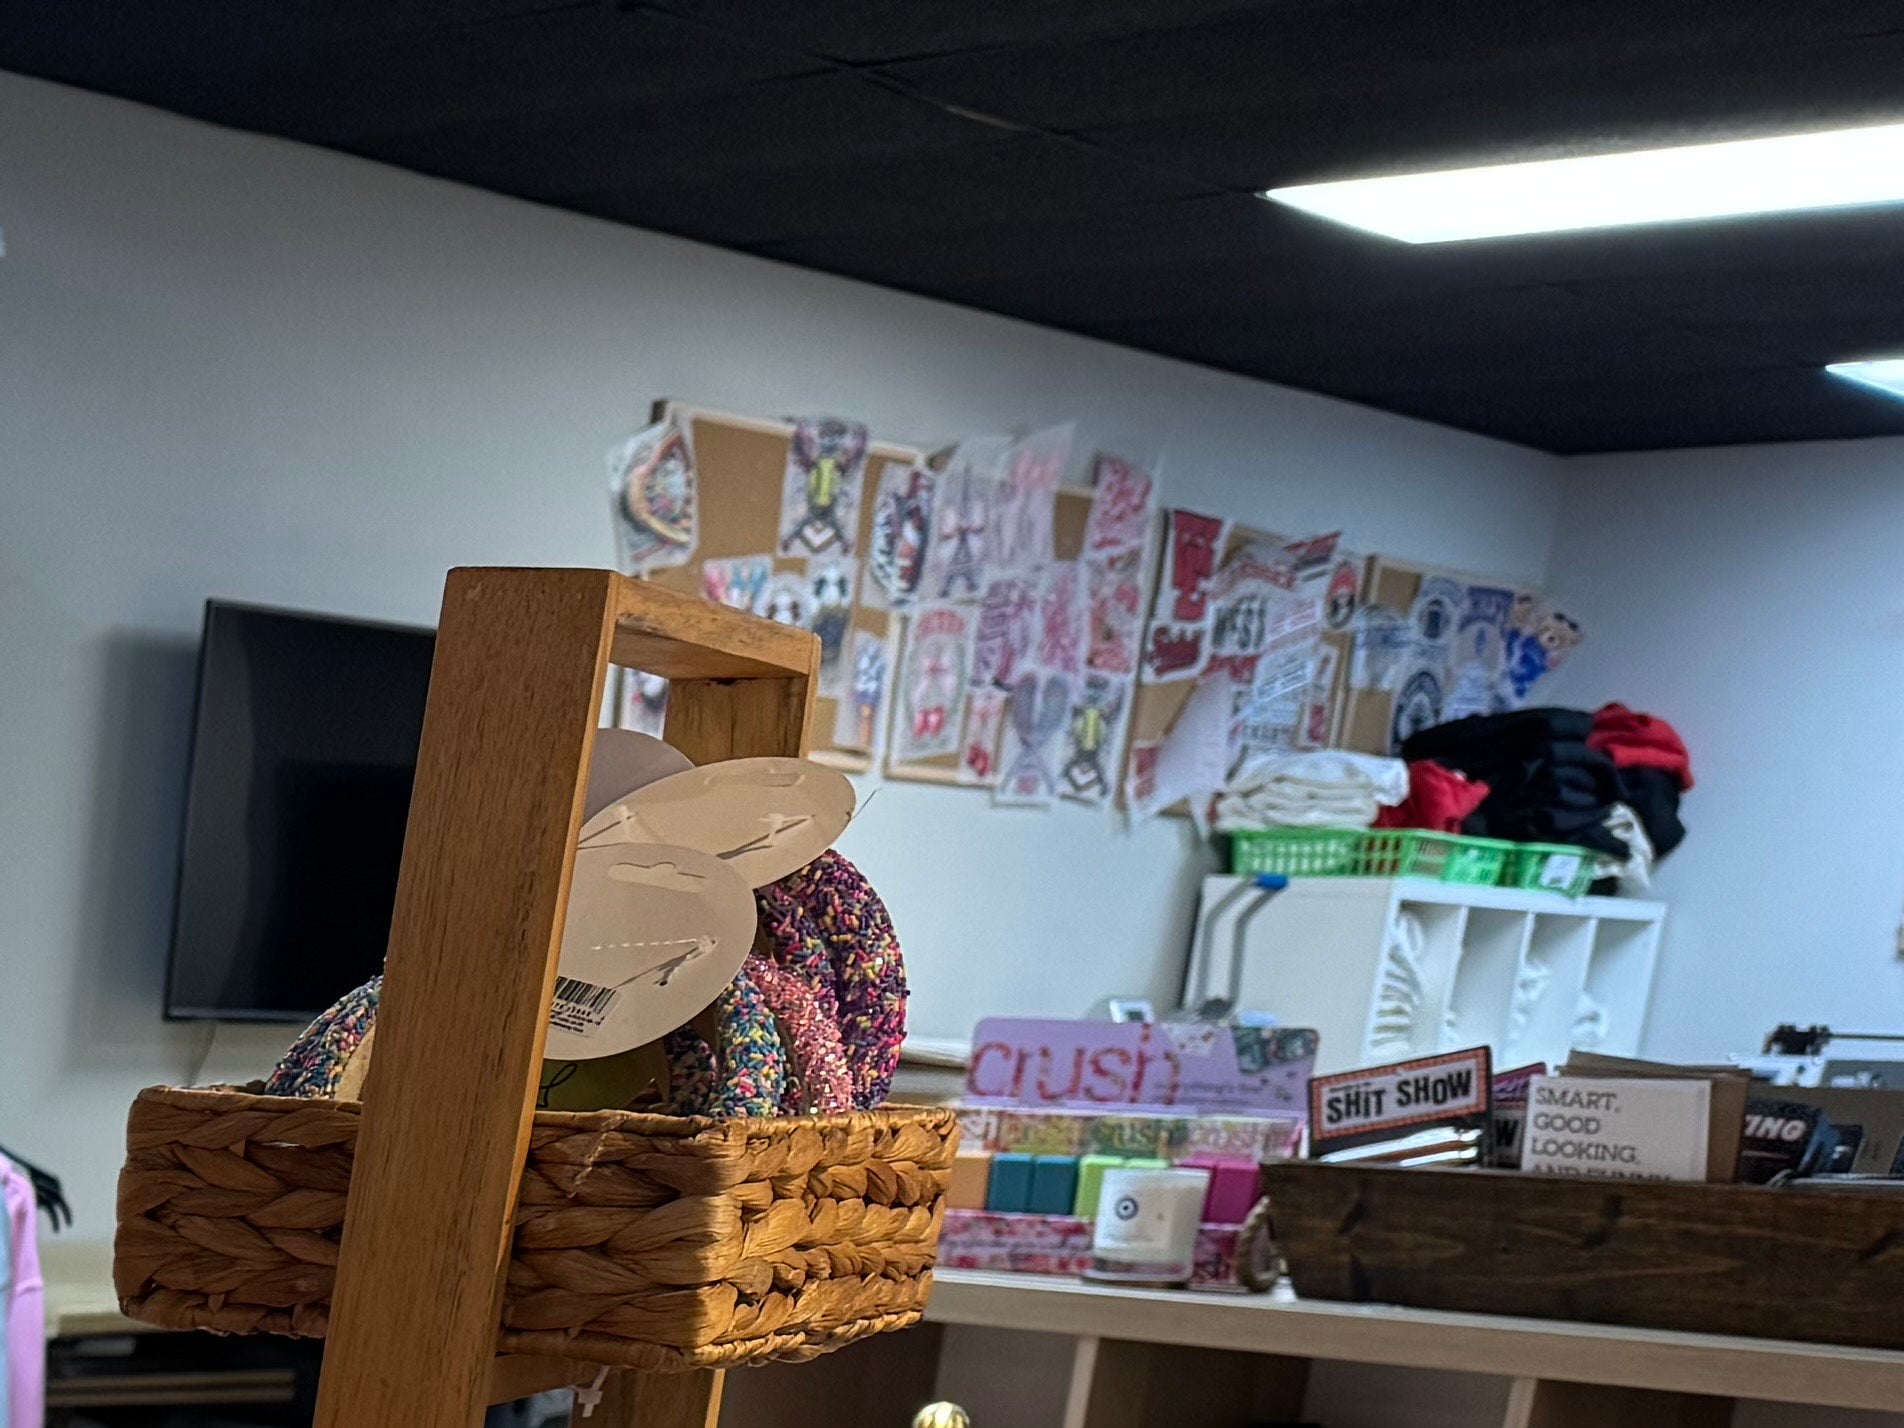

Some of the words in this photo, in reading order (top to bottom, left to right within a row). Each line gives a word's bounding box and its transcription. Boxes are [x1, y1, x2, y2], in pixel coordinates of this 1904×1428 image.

[966, 1022, 1182, 1106] crush
[1326, 1086, 1387, 1125] SHIT
[1396, 1068, 1473, 1108] SHOW
[1533, 1112, 1601, 1135] GOOD
